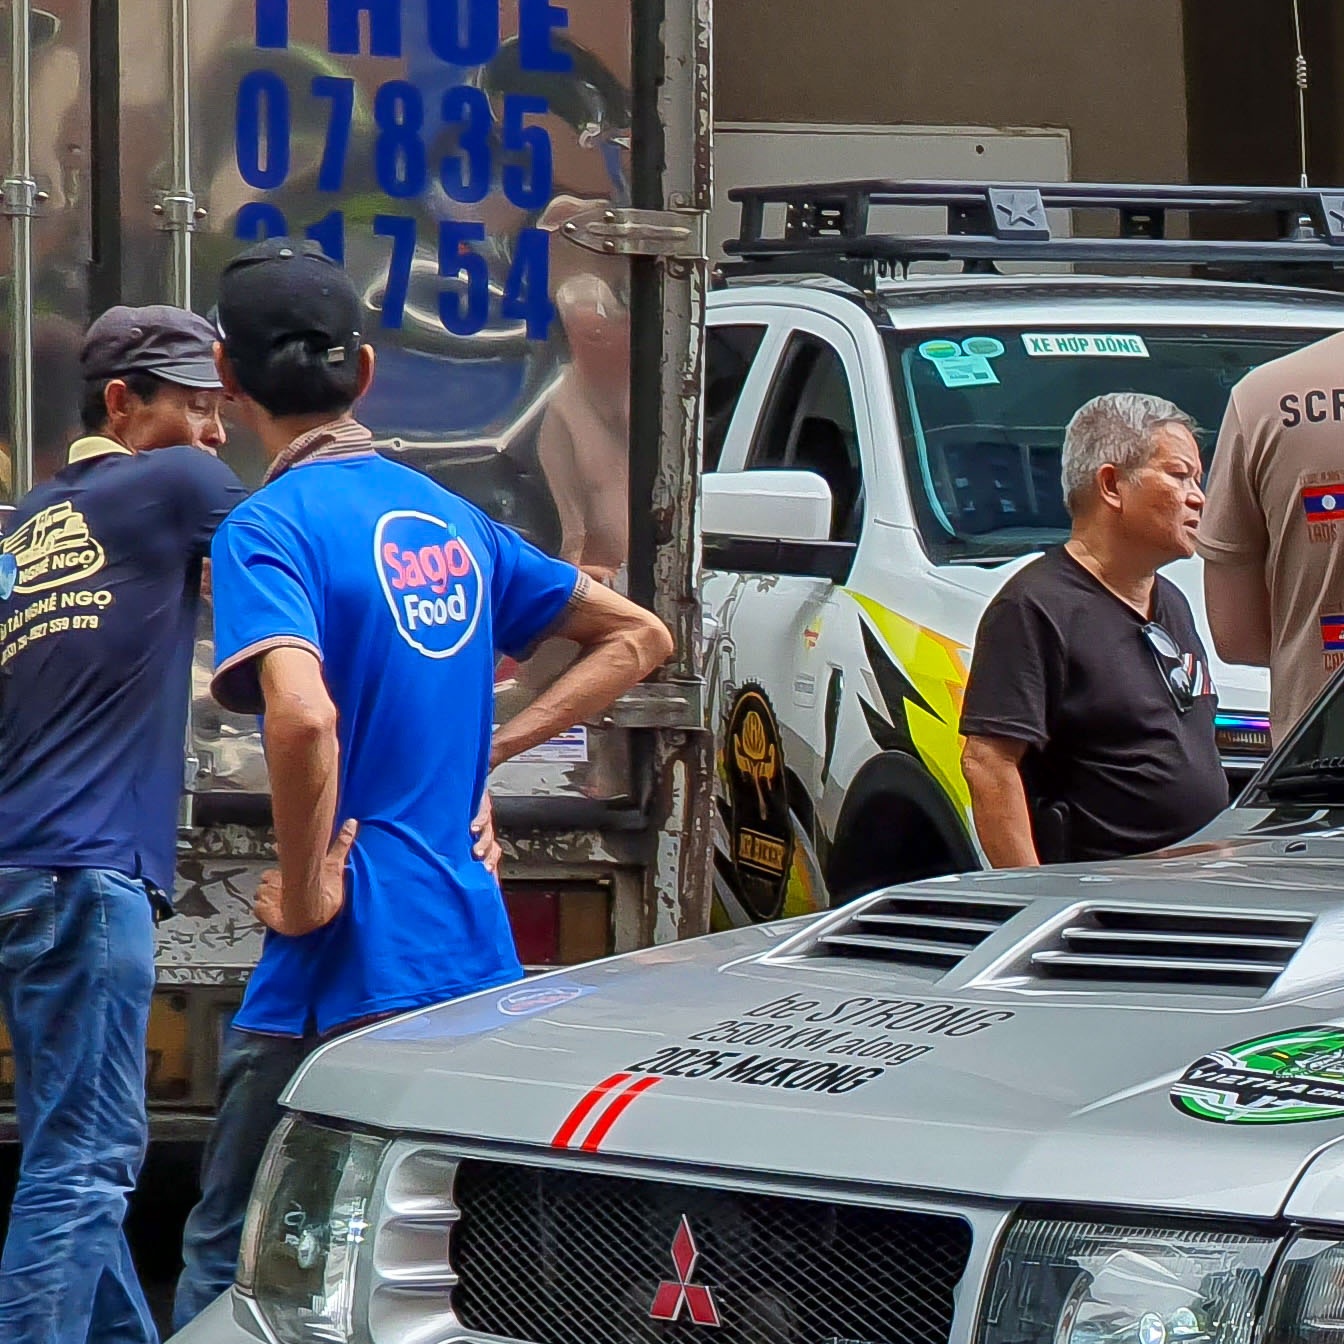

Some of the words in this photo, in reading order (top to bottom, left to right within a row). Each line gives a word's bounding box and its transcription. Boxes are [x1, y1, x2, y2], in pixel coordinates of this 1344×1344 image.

[235, 70, 552, 210] 07835
[1030, 338, 1053, 353] XE
[383, 540, 470, 594] Sago
[403, 584, 467, 630] Food
[743, 993, 820, 1019] be
[805, 998, 1015, 1037] STRONG
[688, 1020, 776, 1046] 2500
[770, 1025, 834, 1051] KM
[826, 1035, 934, 1065] along
[625, 1047, 741, 1078] 2025
[719, 1055, 885, 1094] MEKONG
